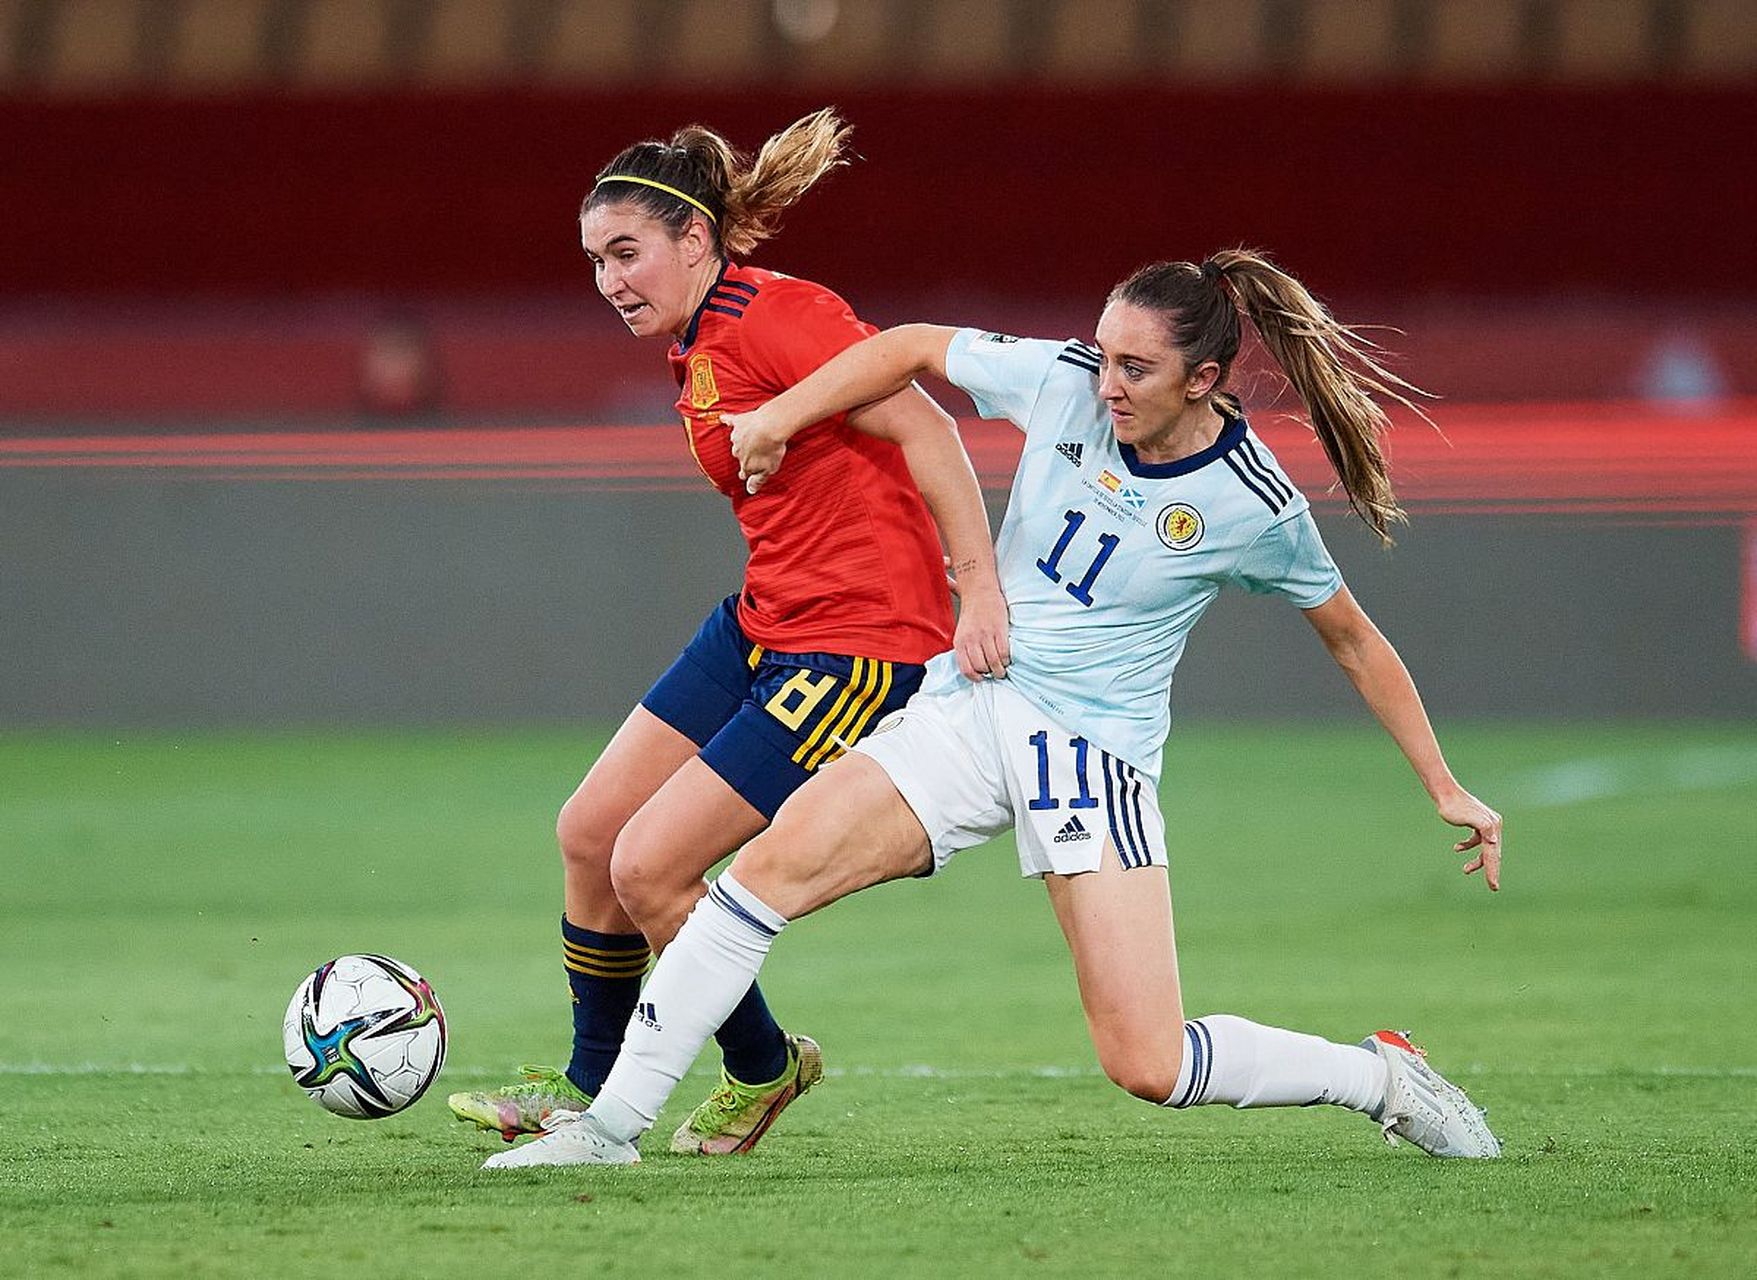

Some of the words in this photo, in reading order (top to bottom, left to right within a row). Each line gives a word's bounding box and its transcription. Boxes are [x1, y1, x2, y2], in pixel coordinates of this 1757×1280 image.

[1036, 509, 1121, 607] 11
[1029, 730, 1099, 810] 11
[1053, 830, 1092, 843] adidas
